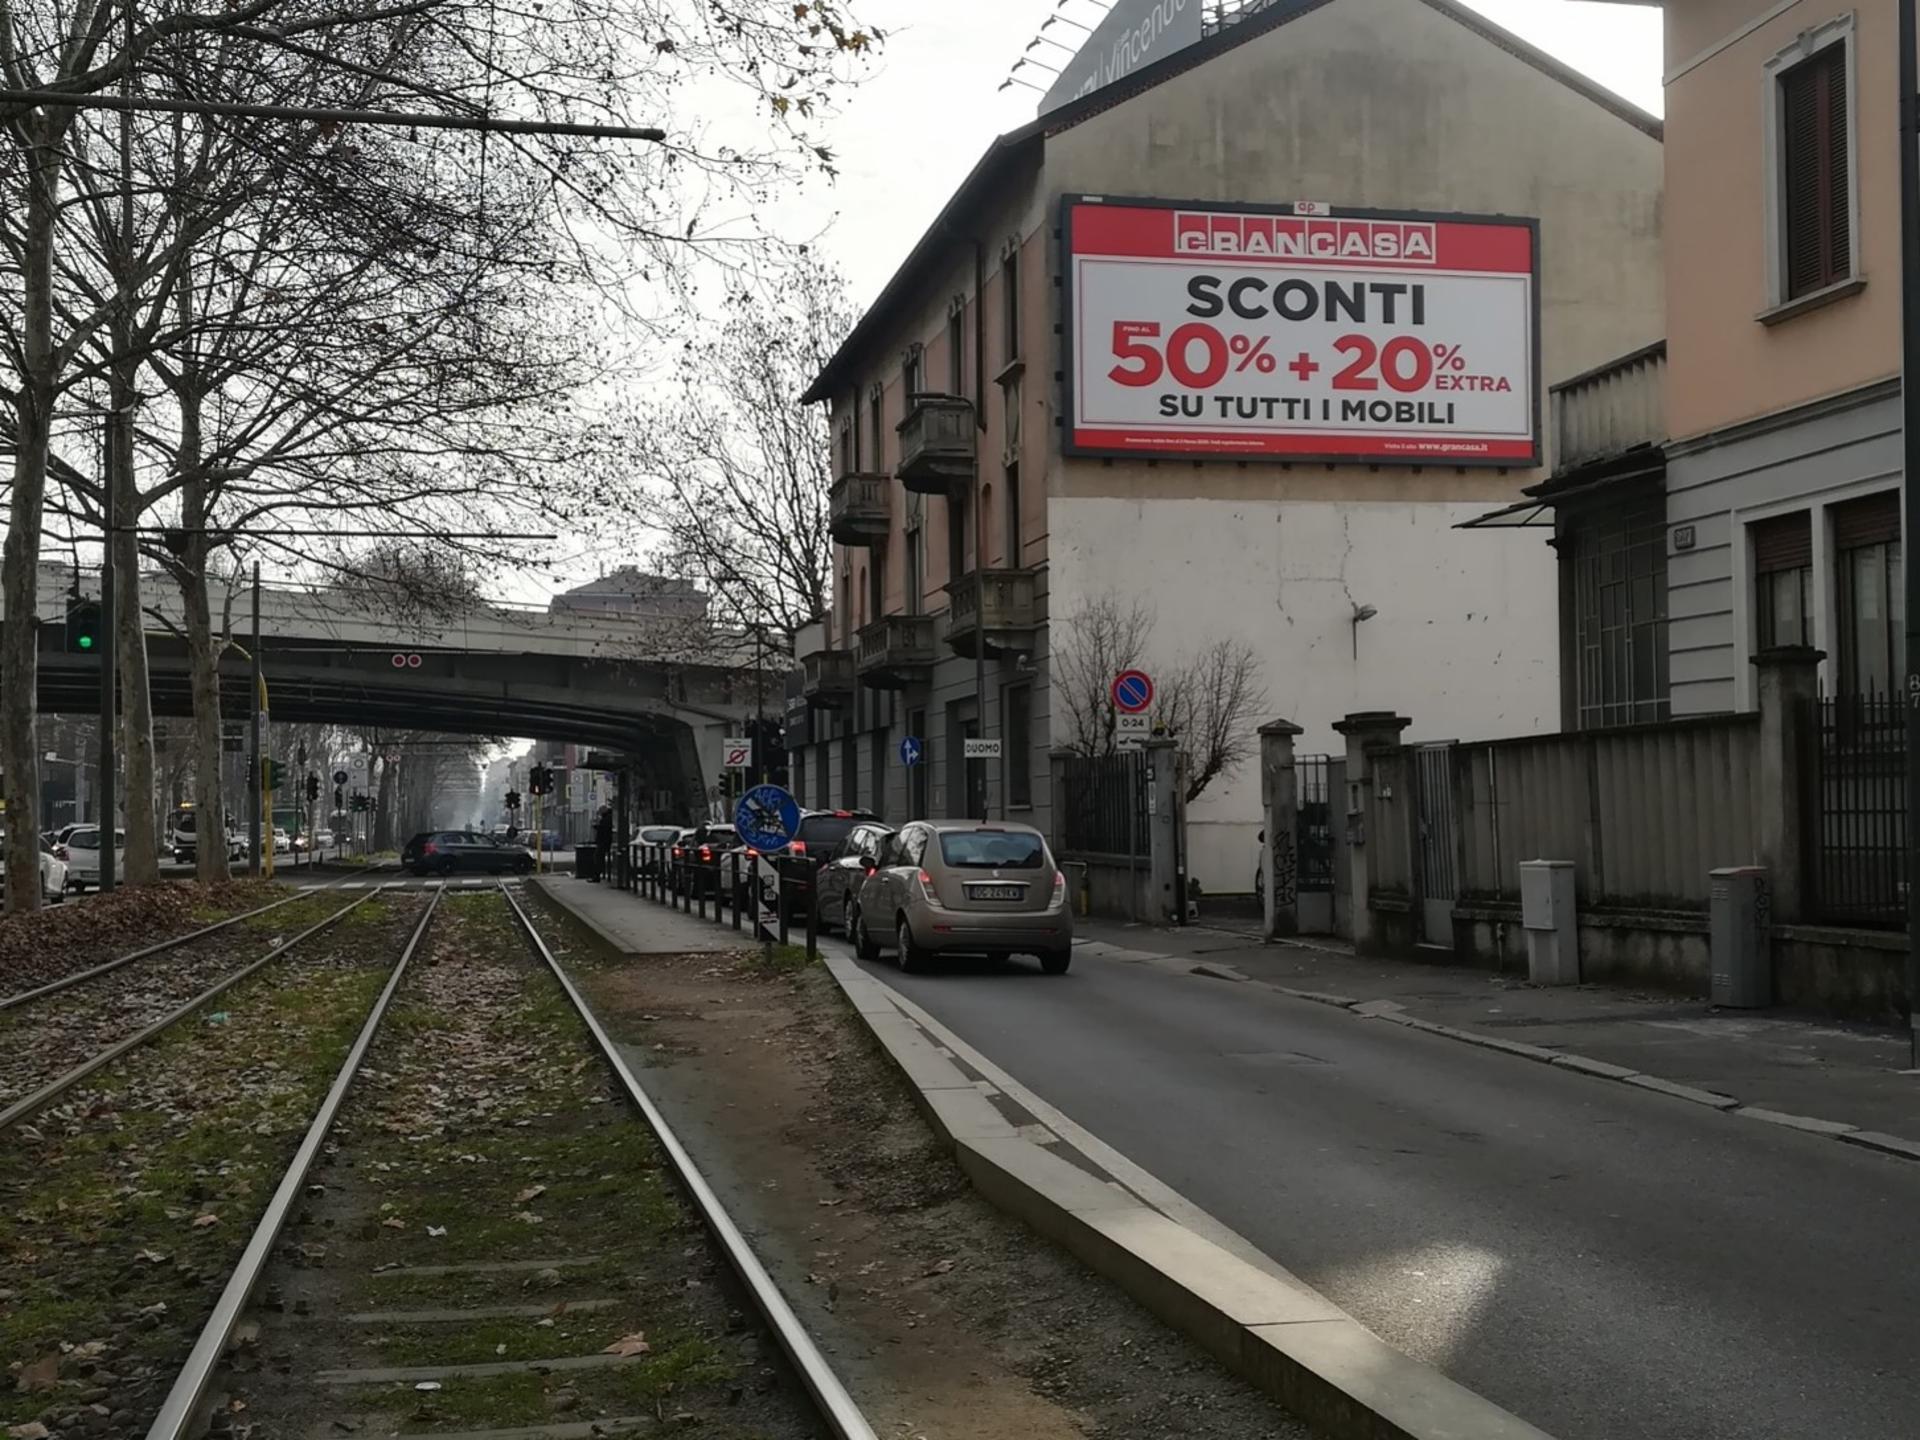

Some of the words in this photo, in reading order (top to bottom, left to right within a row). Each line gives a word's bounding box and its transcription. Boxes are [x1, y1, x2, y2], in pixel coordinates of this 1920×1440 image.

[1178, 230, 1433, 260] GRANCASA
[1186, 274, 1426, 325] SCONTI
[1107, 320, 1277, 390] 50%
[1331, 333, 1466, 394] 20%
[1435, 375, 1512, 393] EXTRA
[1158, 393, 1204, 418] SU
[1213, 395, 1311, 421] TUTTI
[1322, 399, 1330, 421] I
[1341, 399, 1455, 424] MOBILI
[1418, 442, 1488, 452] www.grancasa.it
[966, 743, 1000, 753] DUOMO
